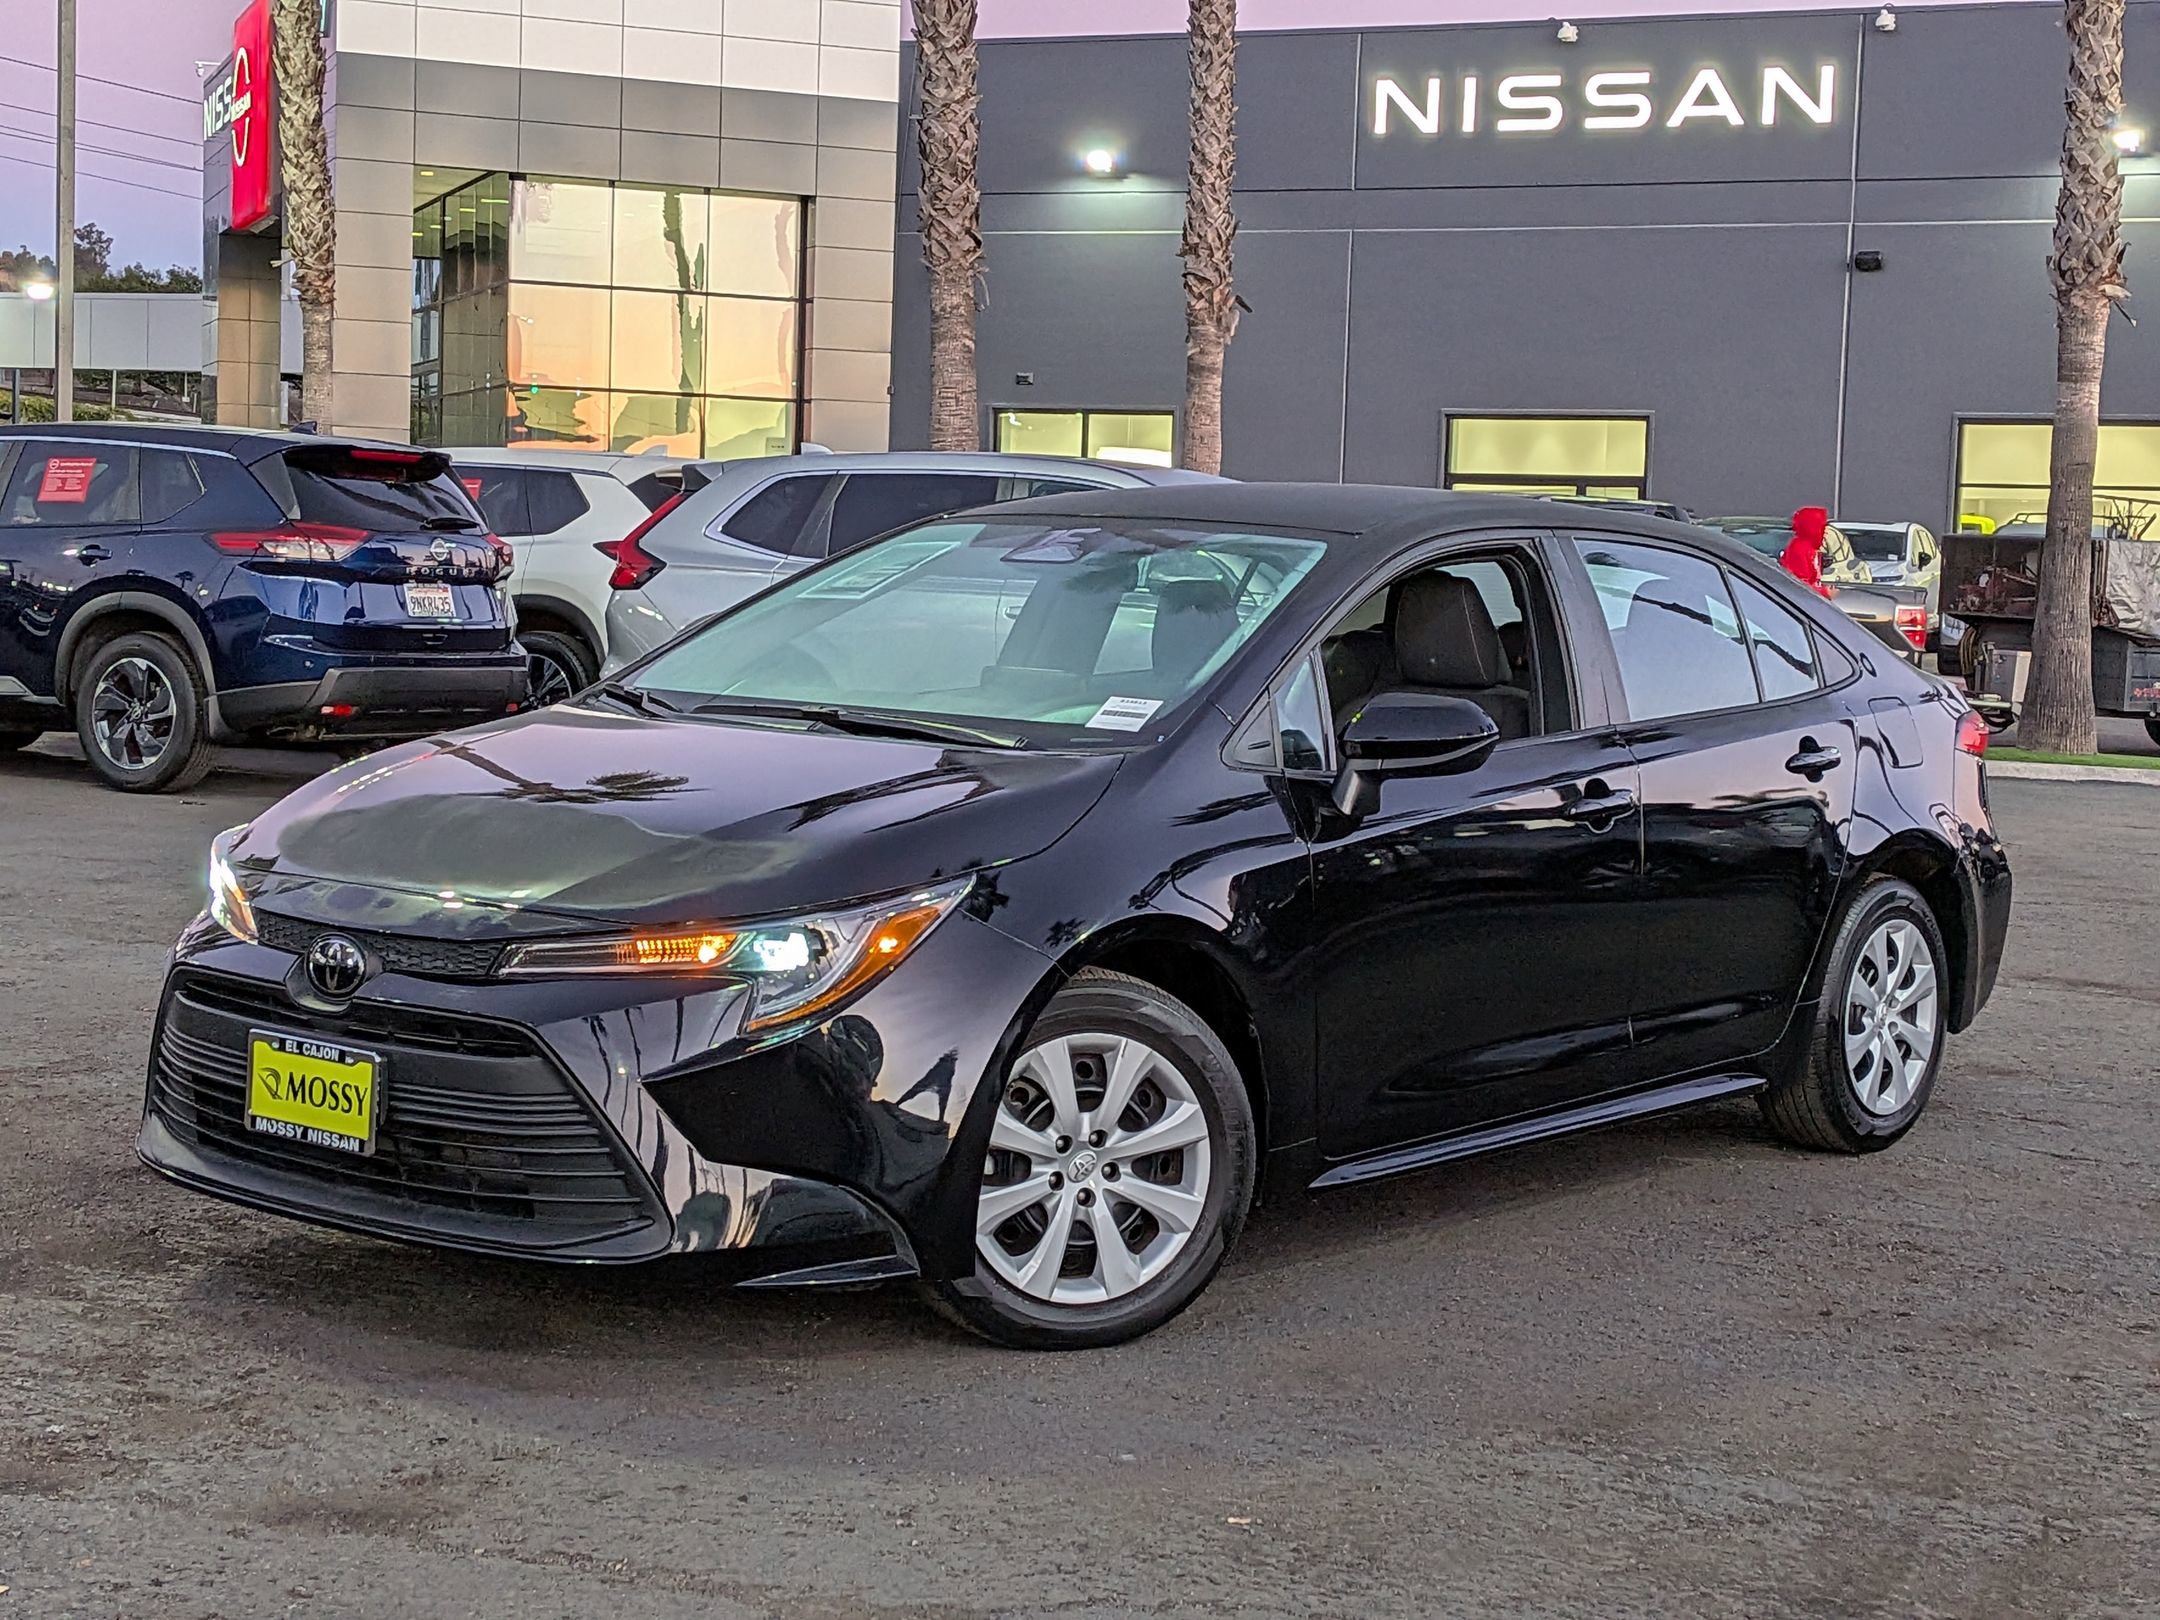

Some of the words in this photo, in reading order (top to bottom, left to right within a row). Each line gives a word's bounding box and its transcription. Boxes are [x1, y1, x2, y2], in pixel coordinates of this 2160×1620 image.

[203, 75, 232, 141] NISS
[1373, 65, 1835, 135] NISSAN
[285, 1039, 300, 1054] EL
[302, 1043, 340, 1062] CAJON
[285, 1071, 368, 1117] MOSSY
[255, 1116, 304, 1139] MOSSY
[307, 1131, 360, 1152] NISSAN
